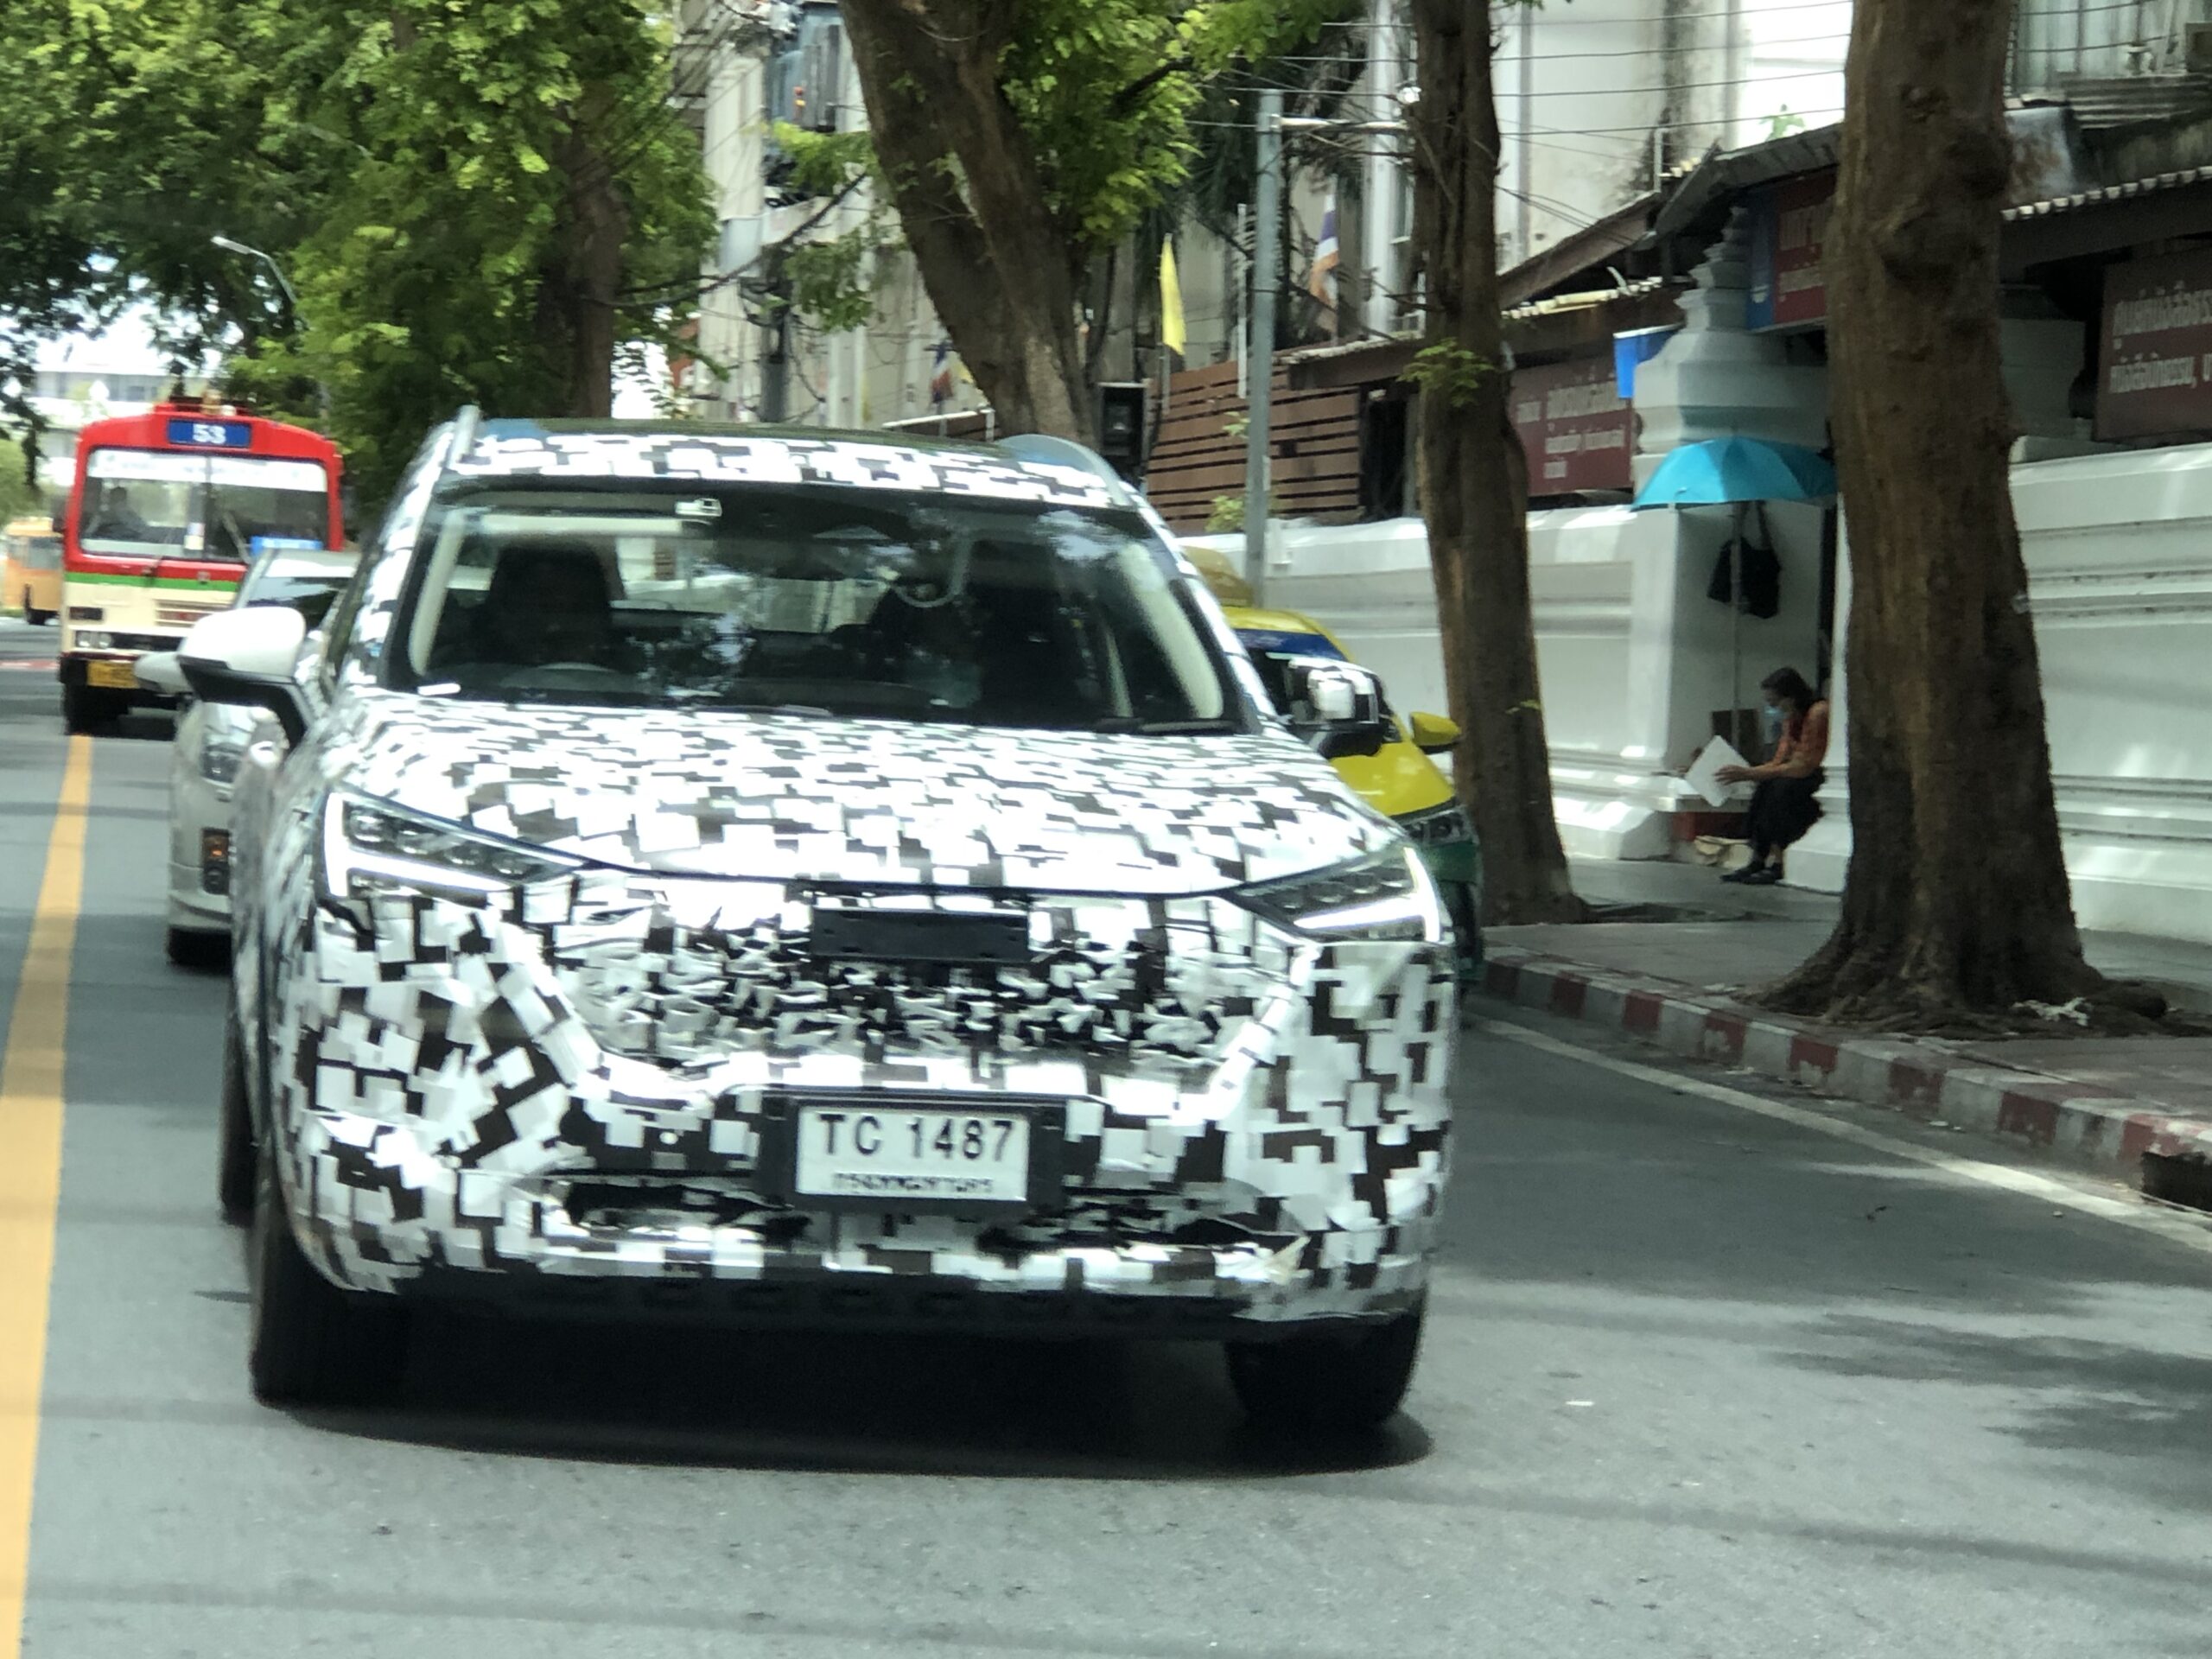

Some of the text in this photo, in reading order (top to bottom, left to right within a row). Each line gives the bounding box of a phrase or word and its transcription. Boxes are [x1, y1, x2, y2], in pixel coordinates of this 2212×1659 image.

[193, 423, 226, 444] 53
[817, 1112, 1014, 1162] TC 1487
